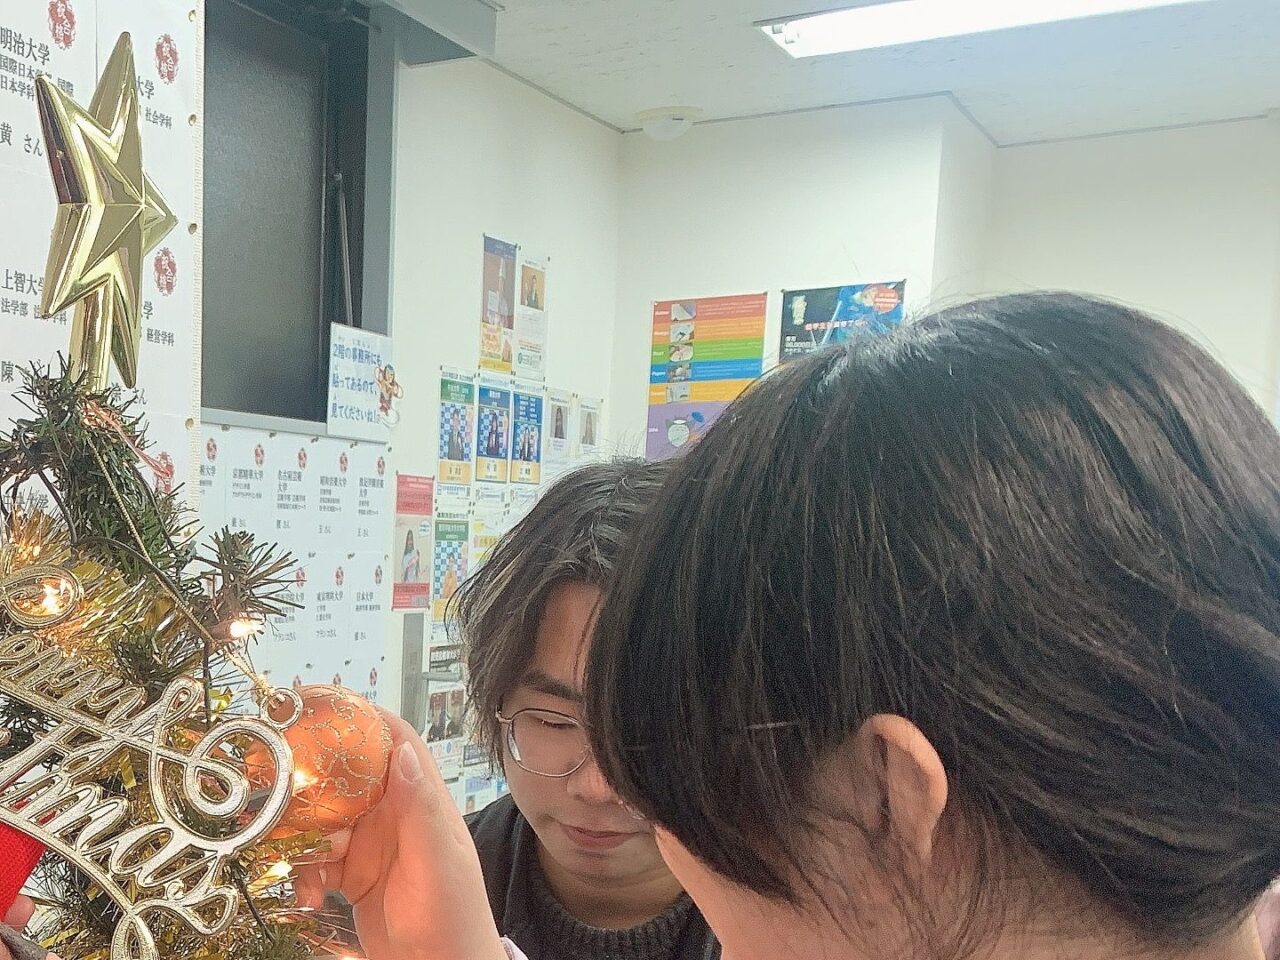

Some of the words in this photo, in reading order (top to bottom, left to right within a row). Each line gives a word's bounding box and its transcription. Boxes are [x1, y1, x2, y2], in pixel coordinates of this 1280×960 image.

[0, 26, 50, 66] 明治大学
[0, 122, 12, 146] 黄
[24, 134, 43, 156] さん
